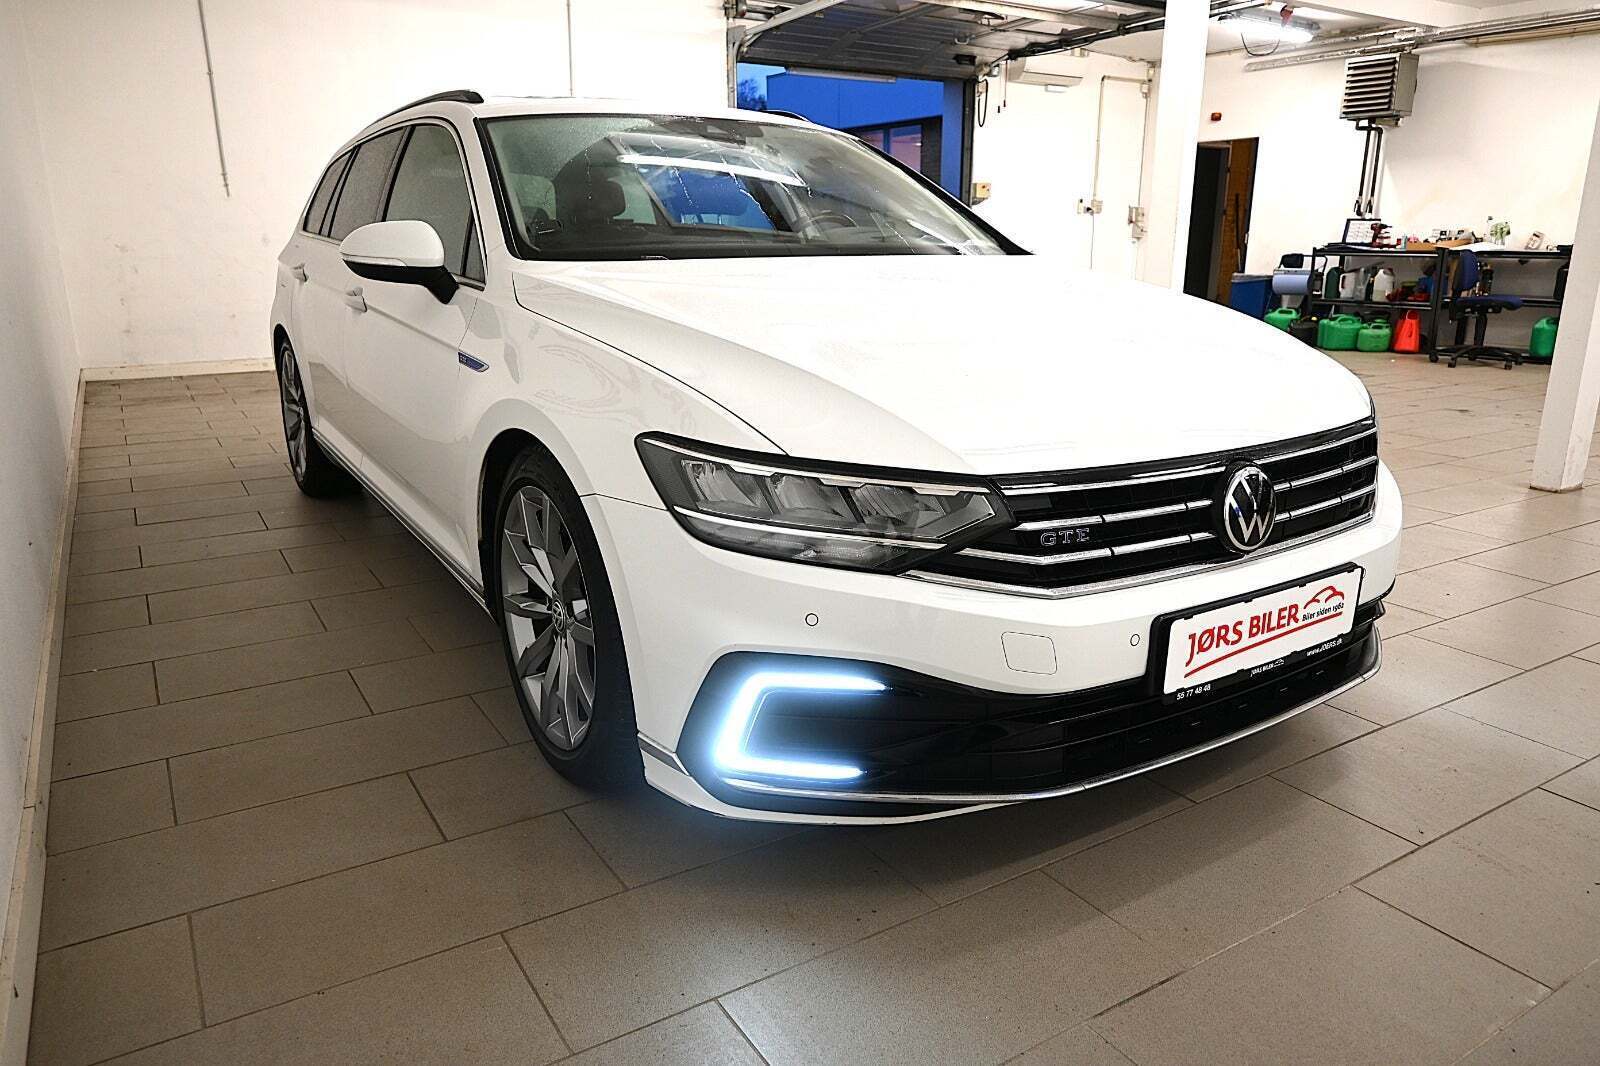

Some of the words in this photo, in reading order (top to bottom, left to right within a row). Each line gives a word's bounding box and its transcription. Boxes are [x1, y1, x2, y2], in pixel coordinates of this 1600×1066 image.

[1040, 527, 1090, 547] GTE
[1302, 612, 1316, 622] Biler
[1316, 607, 1332, 618] siden
[1185, 620, 1244, 667] JØRS
[1248, 603, 1300, 638] BILER
[1176, 691, 1185, 700] 55
[1186, 689, 1194, 698] 77
